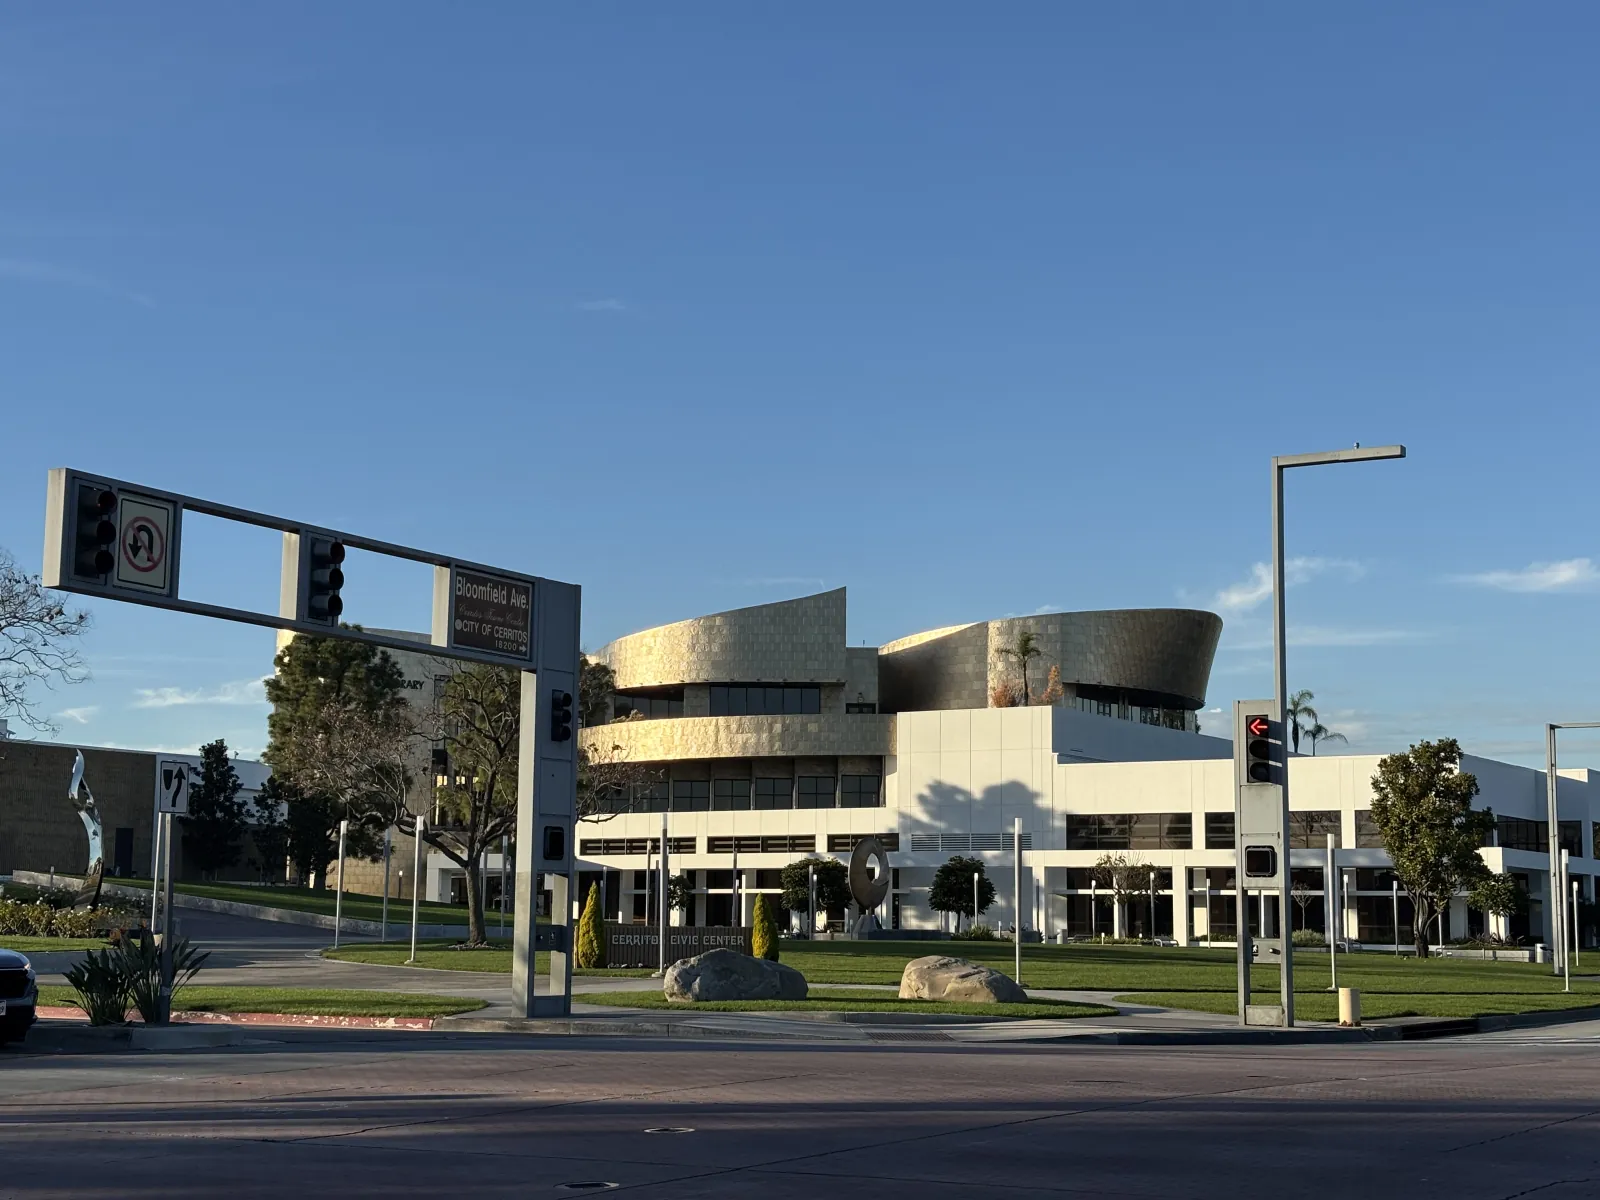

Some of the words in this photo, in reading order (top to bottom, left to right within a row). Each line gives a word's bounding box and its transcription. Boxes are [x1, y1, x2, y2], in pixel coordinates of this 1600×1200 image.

[456, 576, 507, 605] Bloomfield
[510, 587, 529, 609] Ave.
[462, 619, 479, 633] CITY
[481, 623, 492, 636] OF
[494, 625, 528, 643] CERRITOS
[612, 934, 664, 946] CERRITO
[670, 935, 699, 945] CIVIC
[703, 935, 745, 946] CENTER
